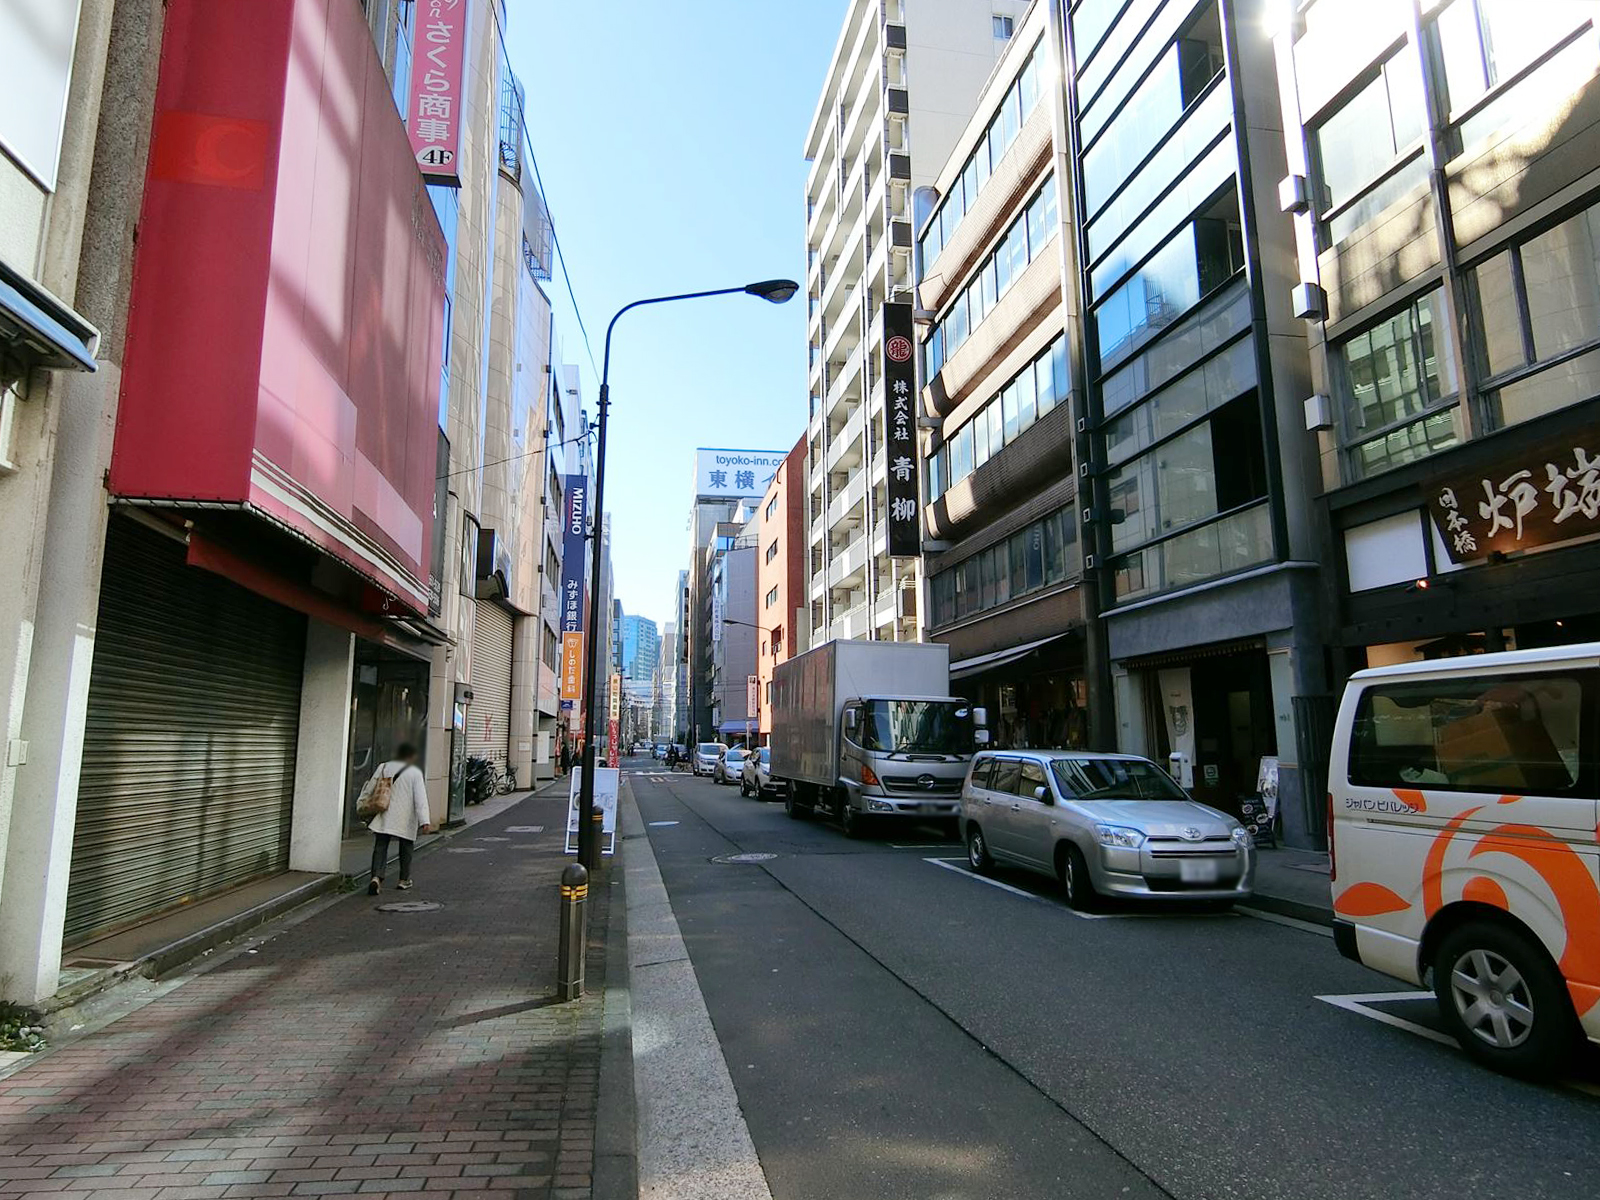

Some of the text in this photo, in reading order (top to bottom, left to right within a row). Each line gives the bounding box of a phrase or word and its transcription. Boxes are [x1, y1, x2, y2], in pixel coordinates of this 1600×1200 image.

[416, 21, 453, 142] さくら商事
[422, 150, 454, 165] 4F
[890, 379, 917, 523] 株式会社 青柳
[571, 487, 584, 535] MIZUHO
[1438, 487, 1478, 555] 日本橋
[565, 579, 579, 632] みずほ銀行
